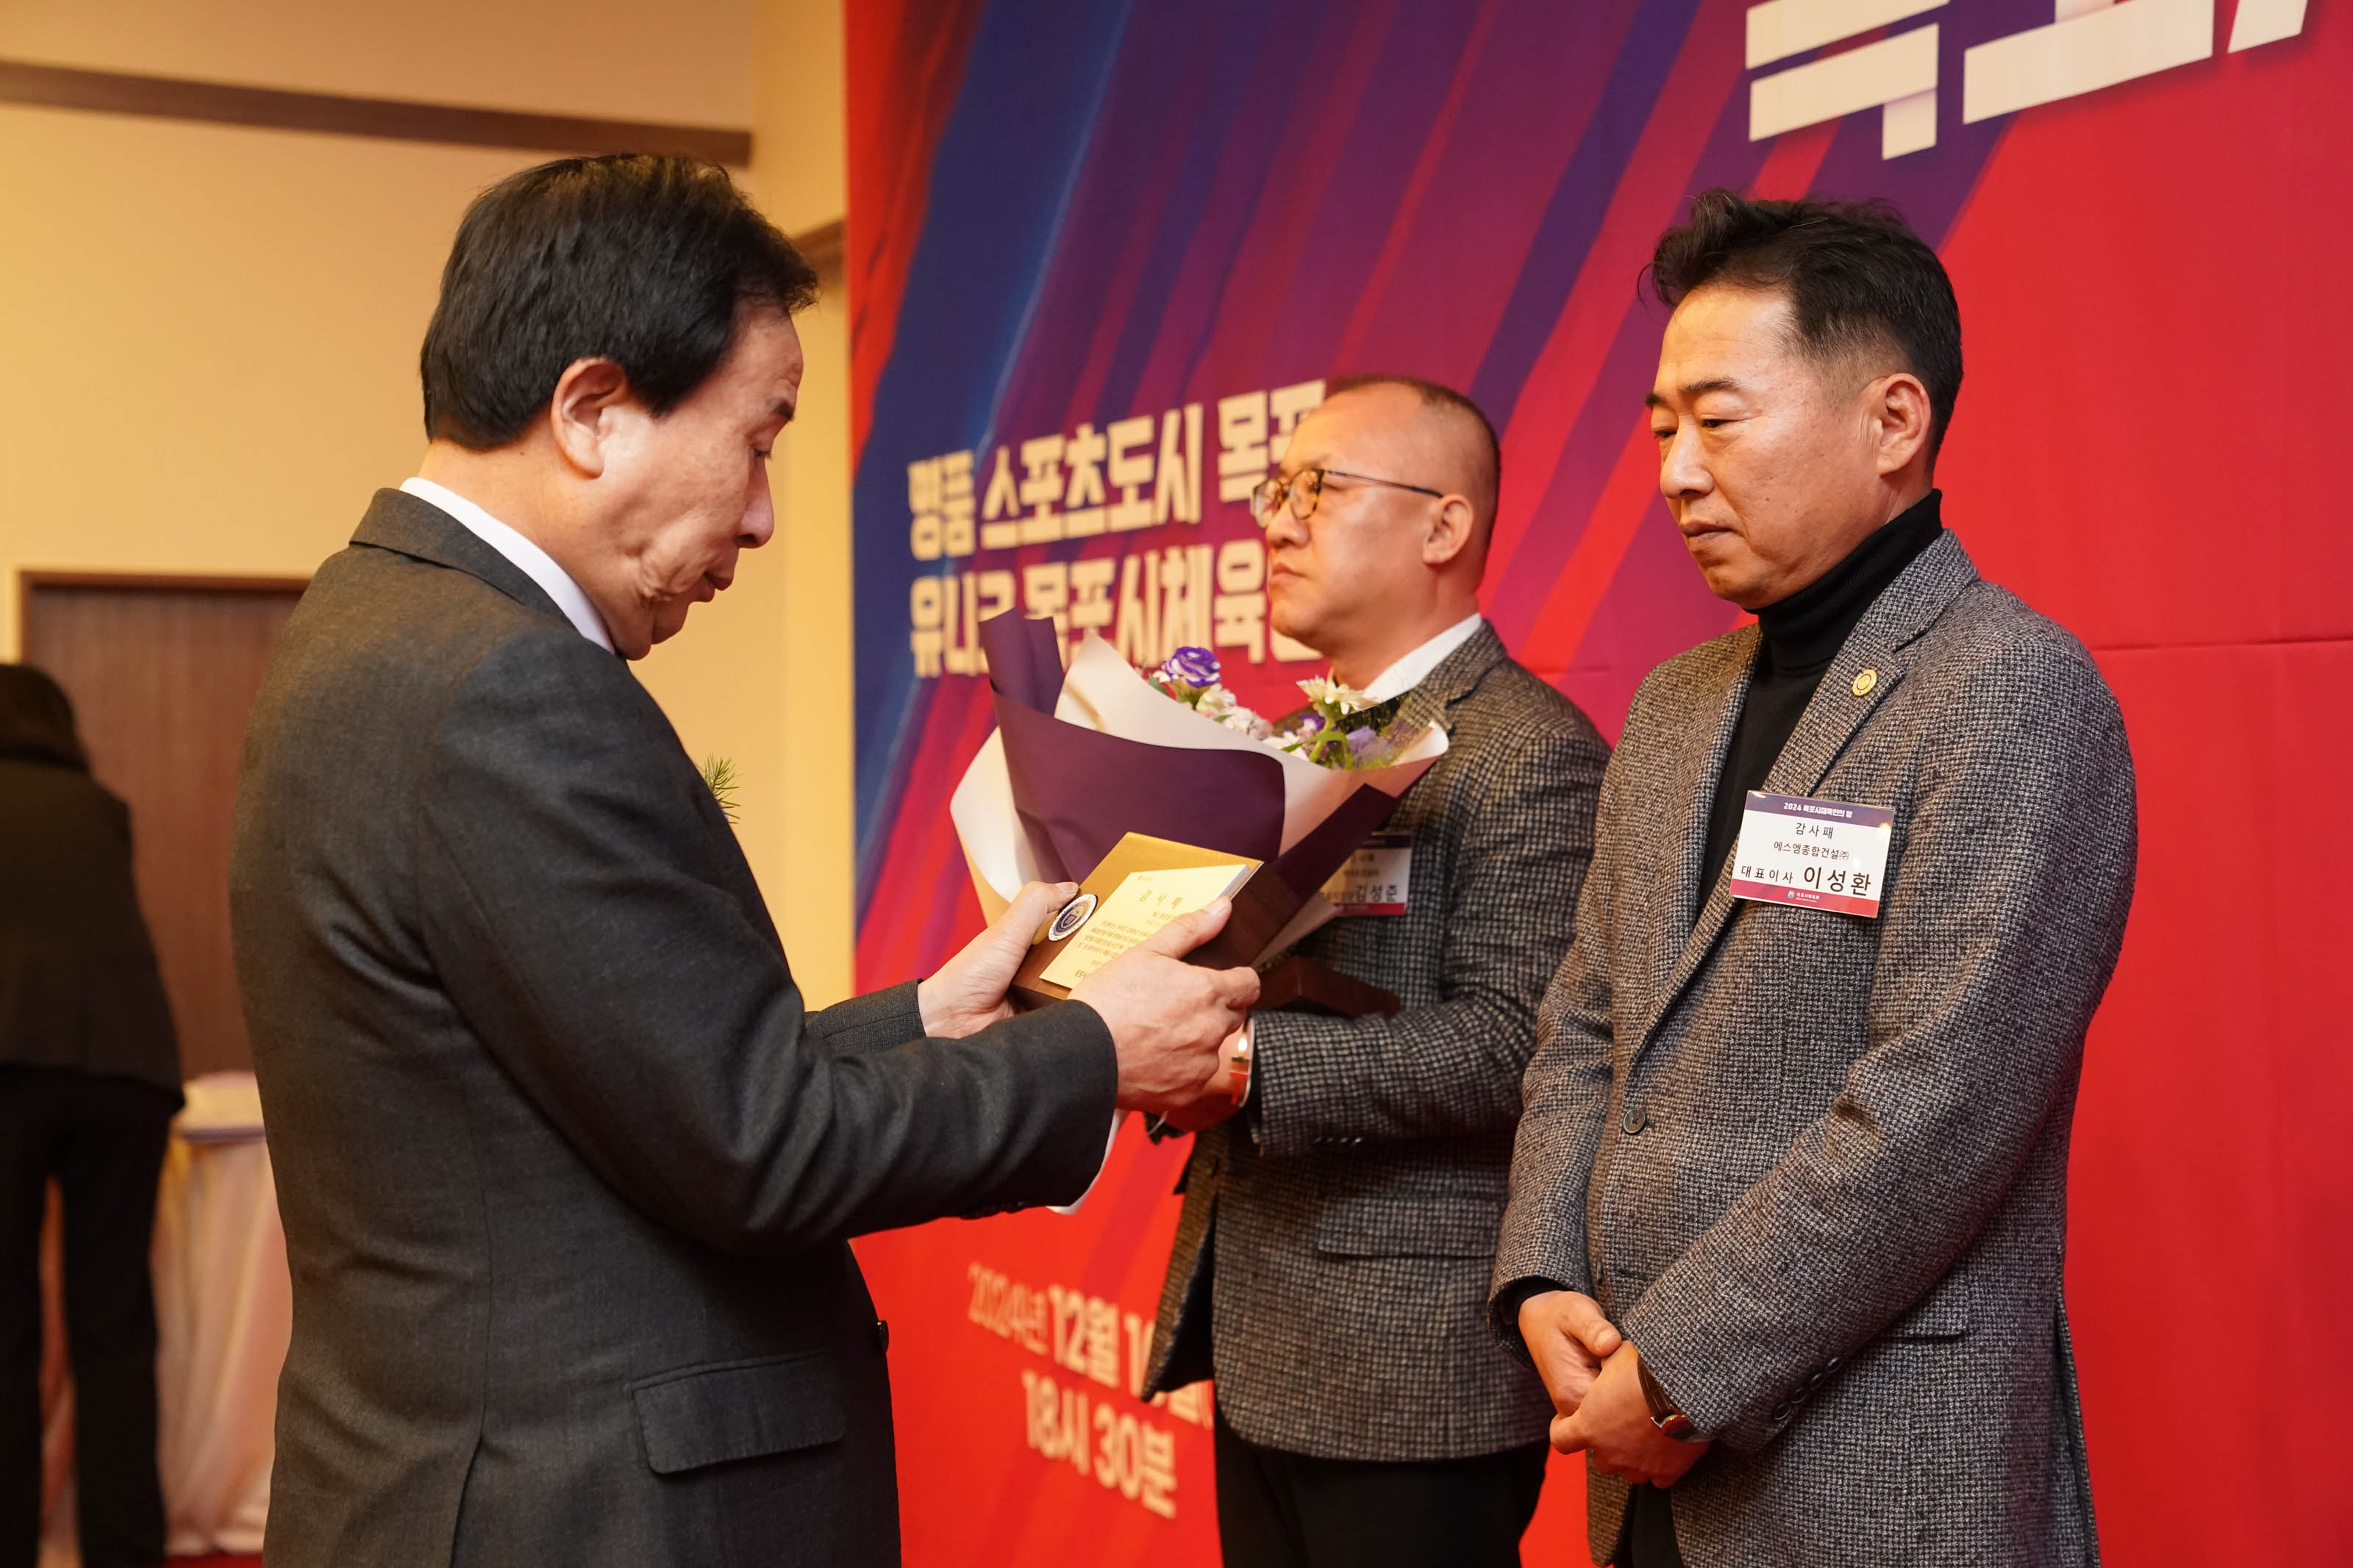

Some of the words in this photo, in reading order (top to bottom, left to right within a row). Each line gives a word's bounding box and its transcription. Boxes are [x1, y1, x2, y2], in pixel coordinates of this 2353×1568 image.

[980, 402, 1204, 550] 스포츠도시
[1023, 538, 1327, 667] 목포시체육
[1784, 803, 1802, 812] 2024
[1741, 865, 1793, 884] 대표이사
[1804, 867, 1871, 897] 이성환
[1049, 1284, 1121, 1389] 12월
[1021, 1368, 1090, 1476] 18시
[1093, 1402, 1177, 1520] 30분
